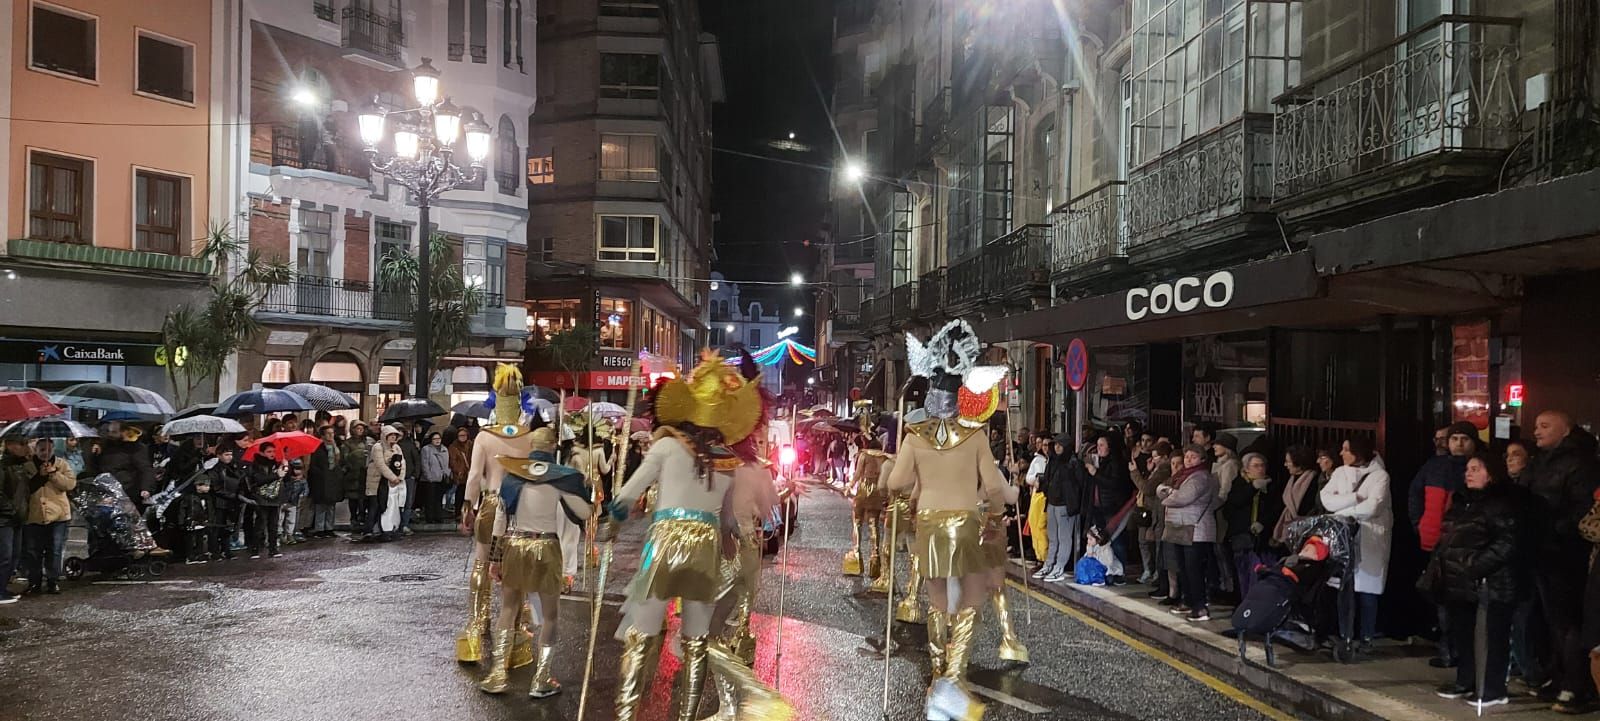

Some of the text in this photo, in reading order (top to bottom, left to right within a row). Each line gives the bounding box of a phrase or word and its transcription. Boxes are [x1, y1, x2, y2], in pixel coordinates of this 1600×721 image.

[1126, 271, 1234, 320] COCO
[63, 346, 124, 360] CaixaBank
[603, 356, 632, 367] RIESGO
